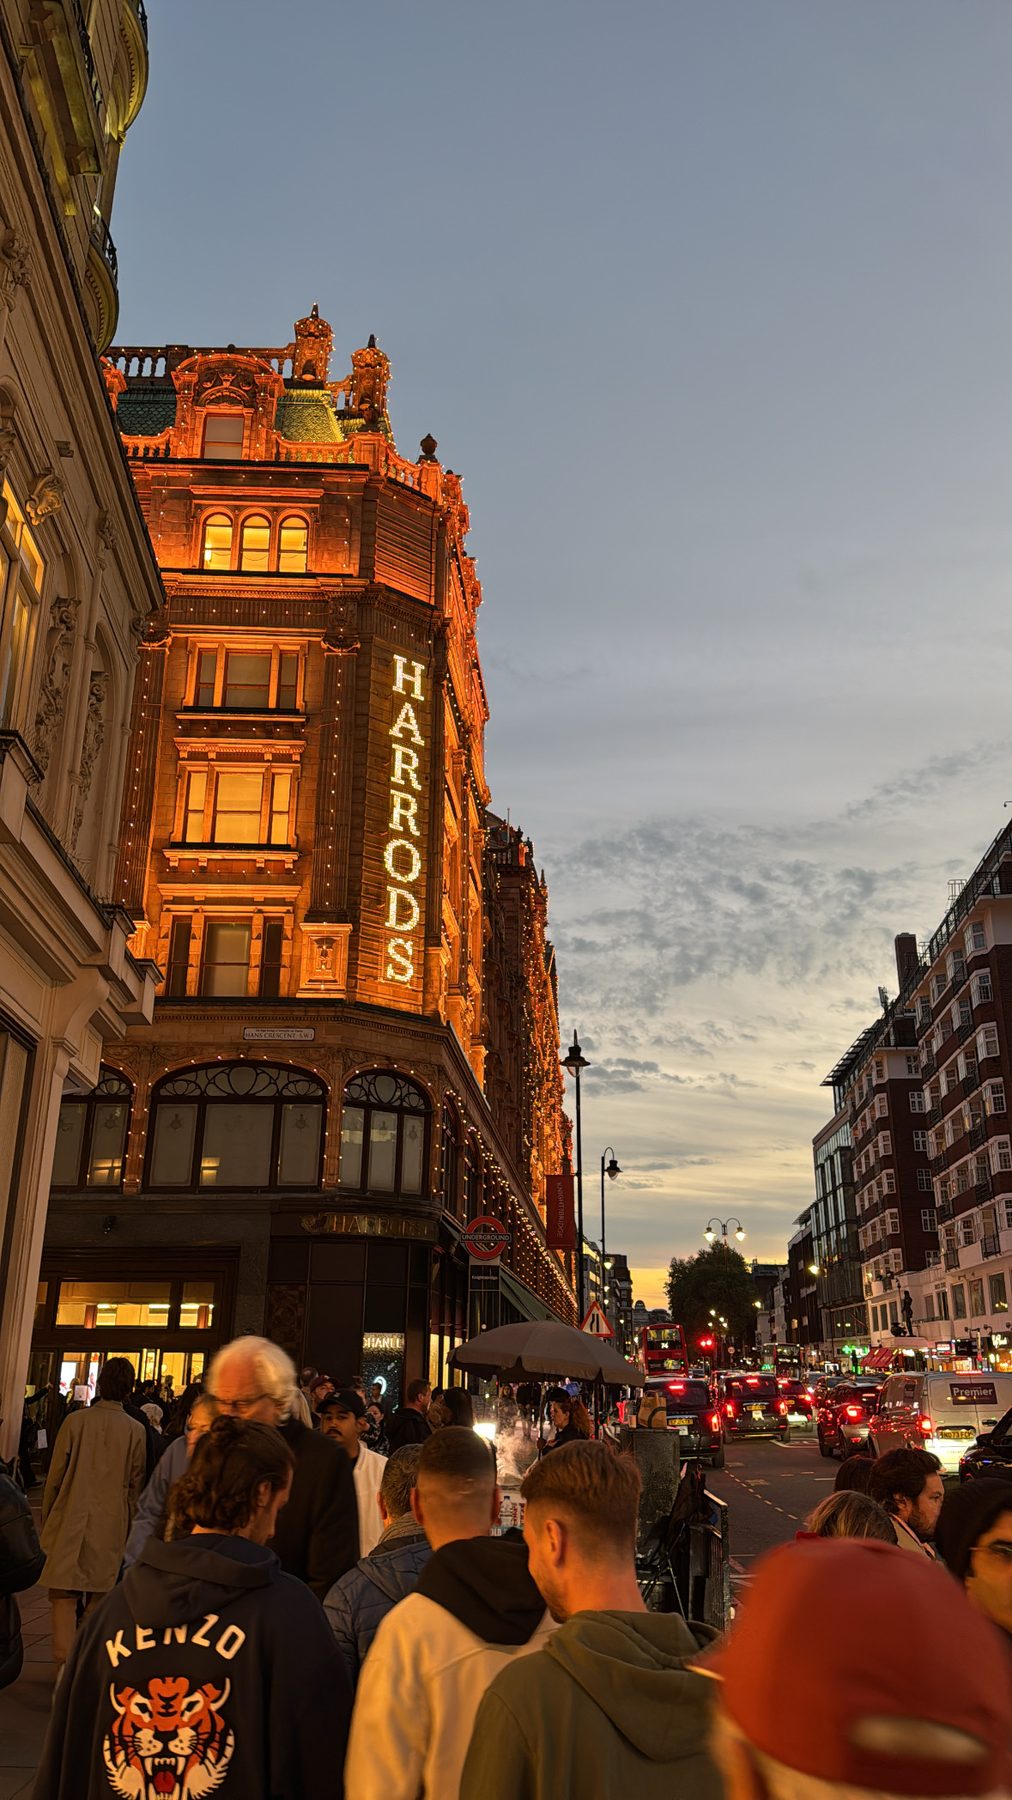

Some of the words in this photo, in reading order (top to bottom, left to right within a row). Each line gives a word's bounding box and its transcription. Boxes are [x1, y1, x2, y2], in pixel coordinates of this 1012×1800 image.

[383, 654, 425, 983] HARRODS
[952, 1386, 993, 1397] Premier
[105, 1613, 247, 1668] KENZO
